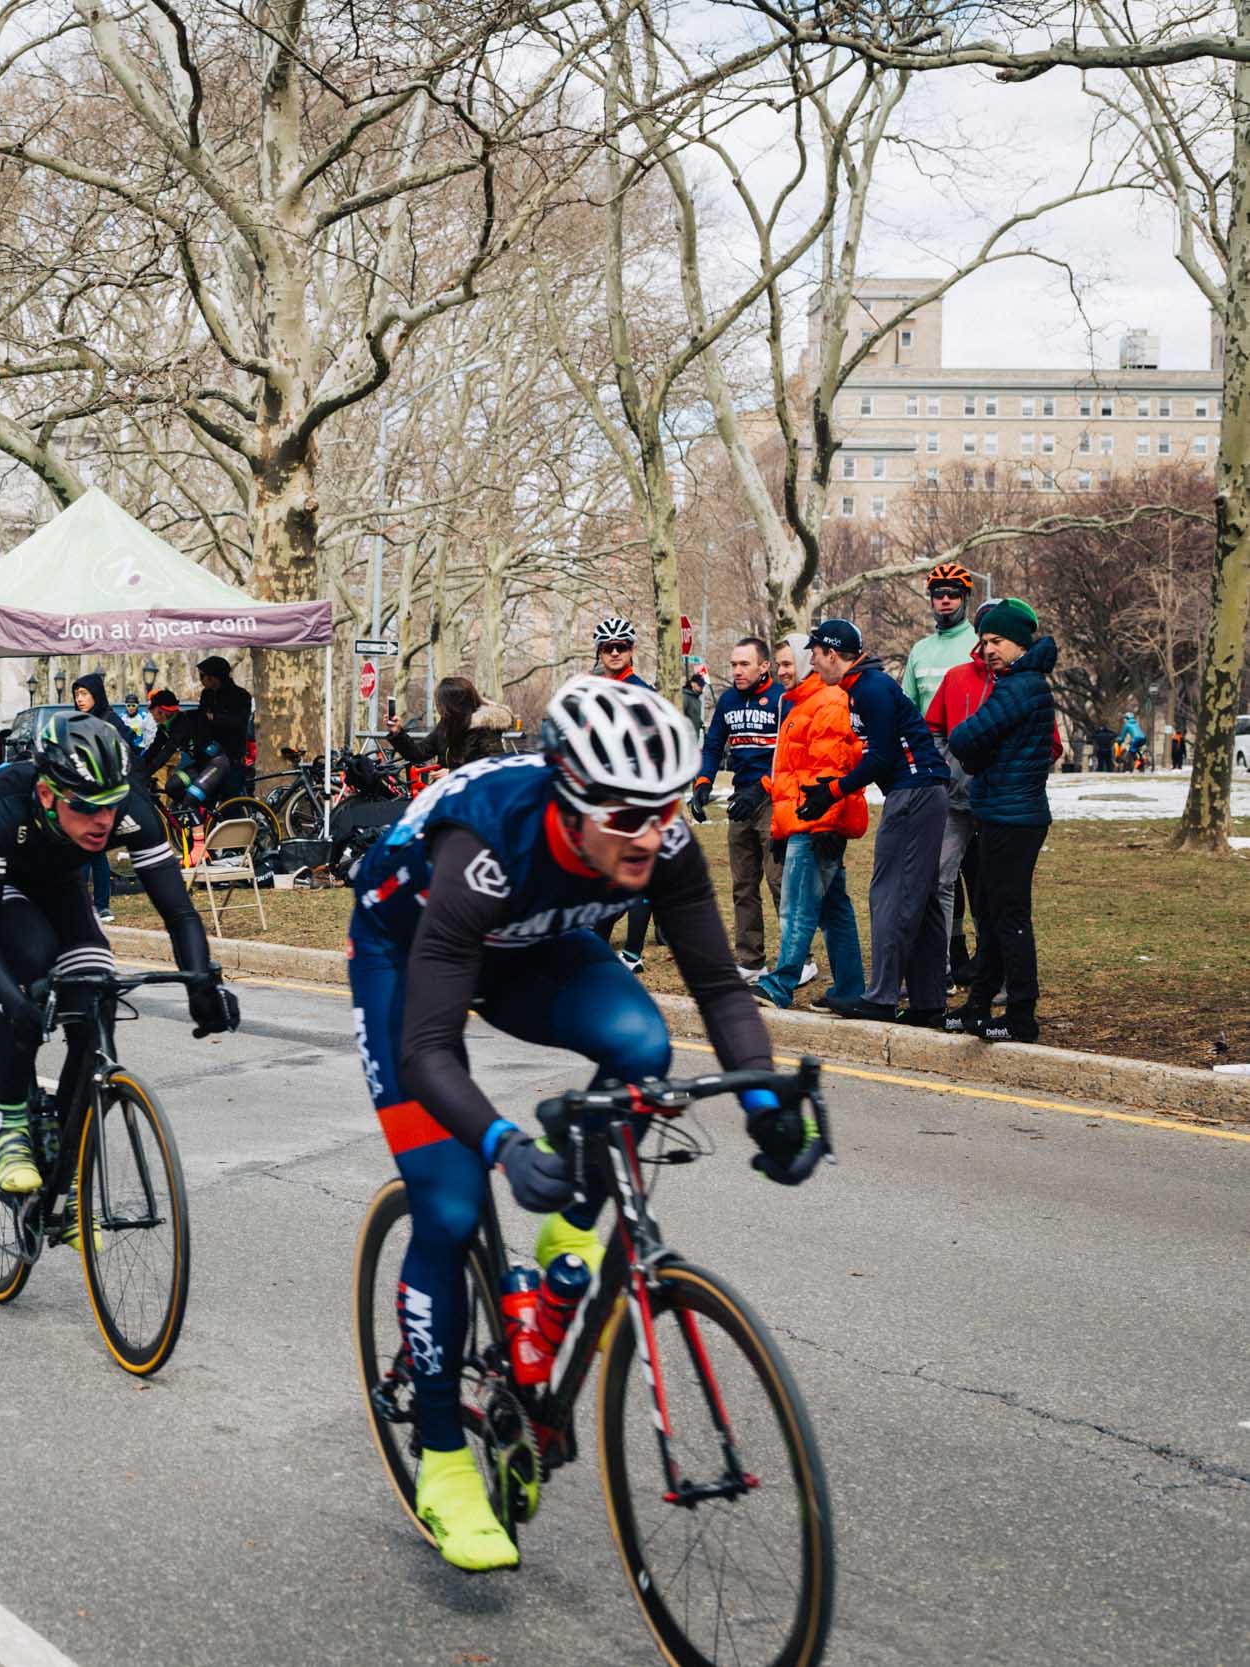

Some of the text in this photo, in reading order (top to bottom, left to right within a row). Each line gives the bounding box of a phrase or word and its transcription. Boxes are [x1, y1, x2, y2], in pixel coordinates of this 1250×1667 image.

[58, 616, 257, 642] Join at zipcar.com
